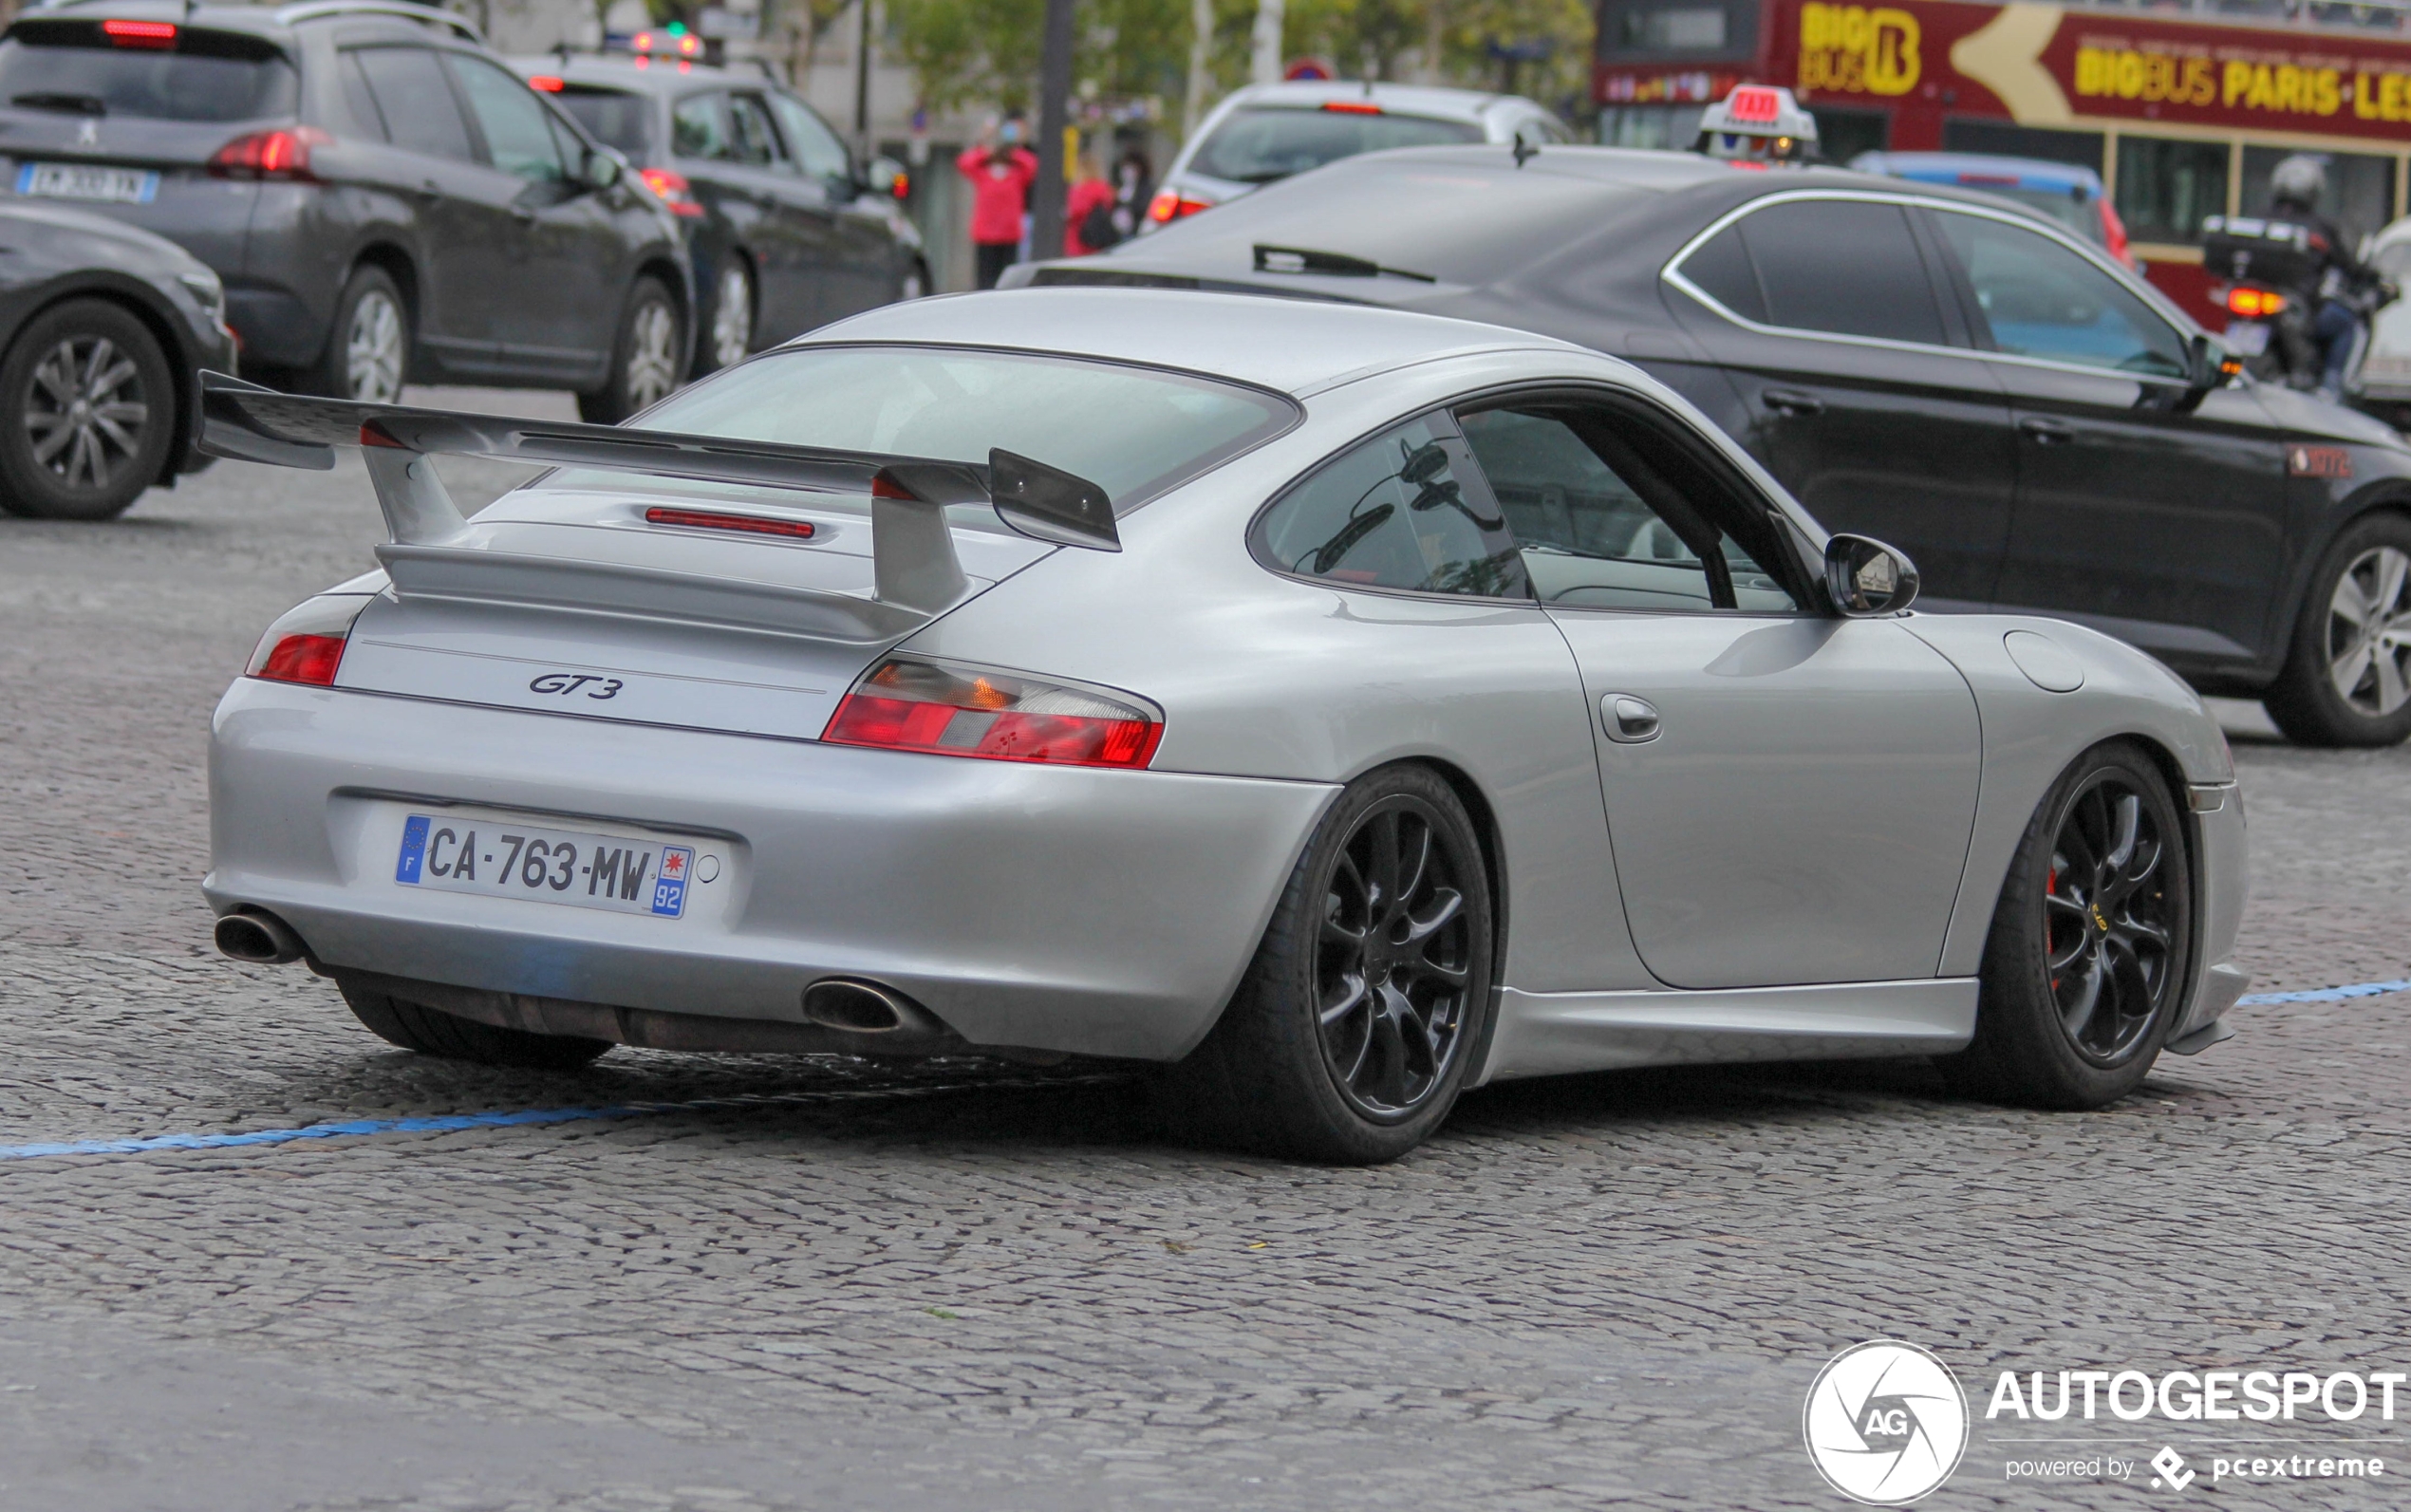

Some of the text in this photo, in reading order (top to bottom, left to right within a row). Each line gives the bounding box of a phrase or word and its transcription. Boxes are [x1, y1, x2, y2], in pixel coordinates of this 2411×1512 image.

[1799, 50, 1866, 92] BUS
[1734, 91, 1778, 117] TAXI
[2223, 60, 2342, 116] PARIS
[2355, 72, 2411, 123] LE
[530, 674, 623, 700] GT3
[404, 857, 414, 871] F
[655, 885, 681, 909] 92
